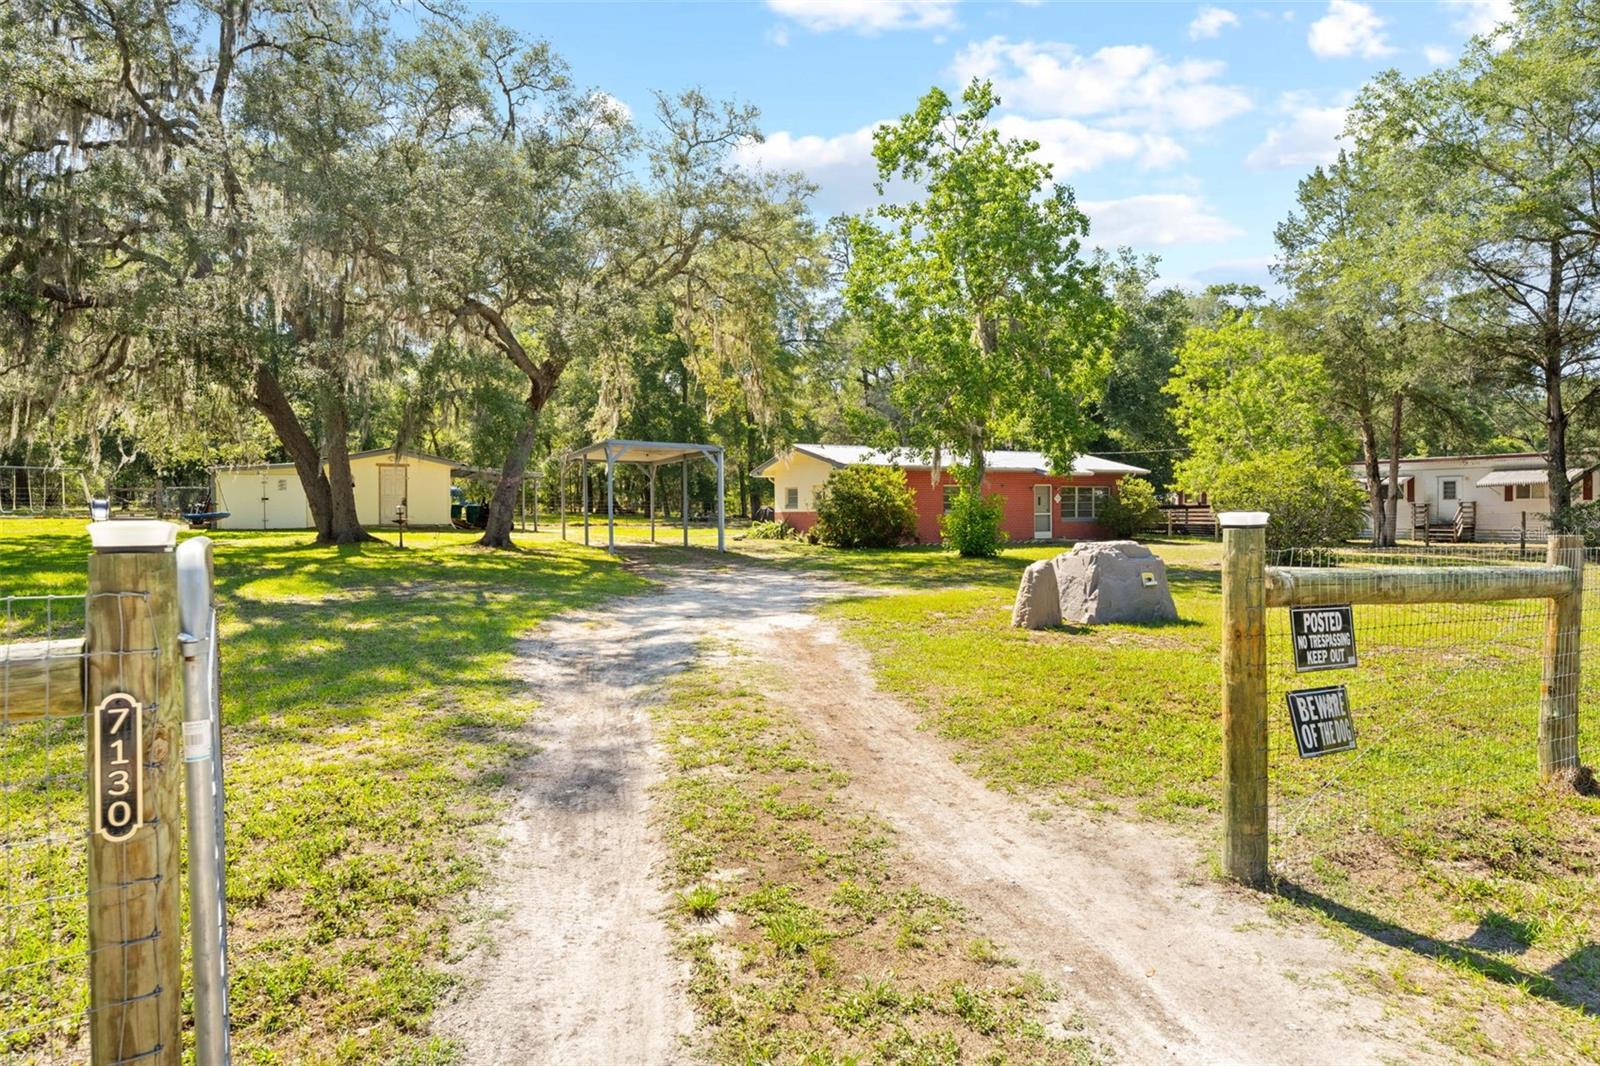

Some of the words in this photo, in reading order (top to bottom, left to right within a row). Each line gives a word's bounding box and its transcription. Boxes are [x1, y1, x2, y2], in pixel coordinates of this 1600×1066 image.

[1303, 611, 1342, 633] POSTED
[1297, 635, 1308, 649] NO
[1308, 632, 1351, 649] TRESPASSING
[1307, 651, 1328, 664] KEEP
[1330, 649, 1345, 662] OUT
[1296, 692, 1346, 722] BEWARE
[1301, 723, 1319, 749] OF
[1318, 721, 1336, 746] THE
[1335, 718, 1352, 744] DOG
[107, 708, 131, 827] 7130
